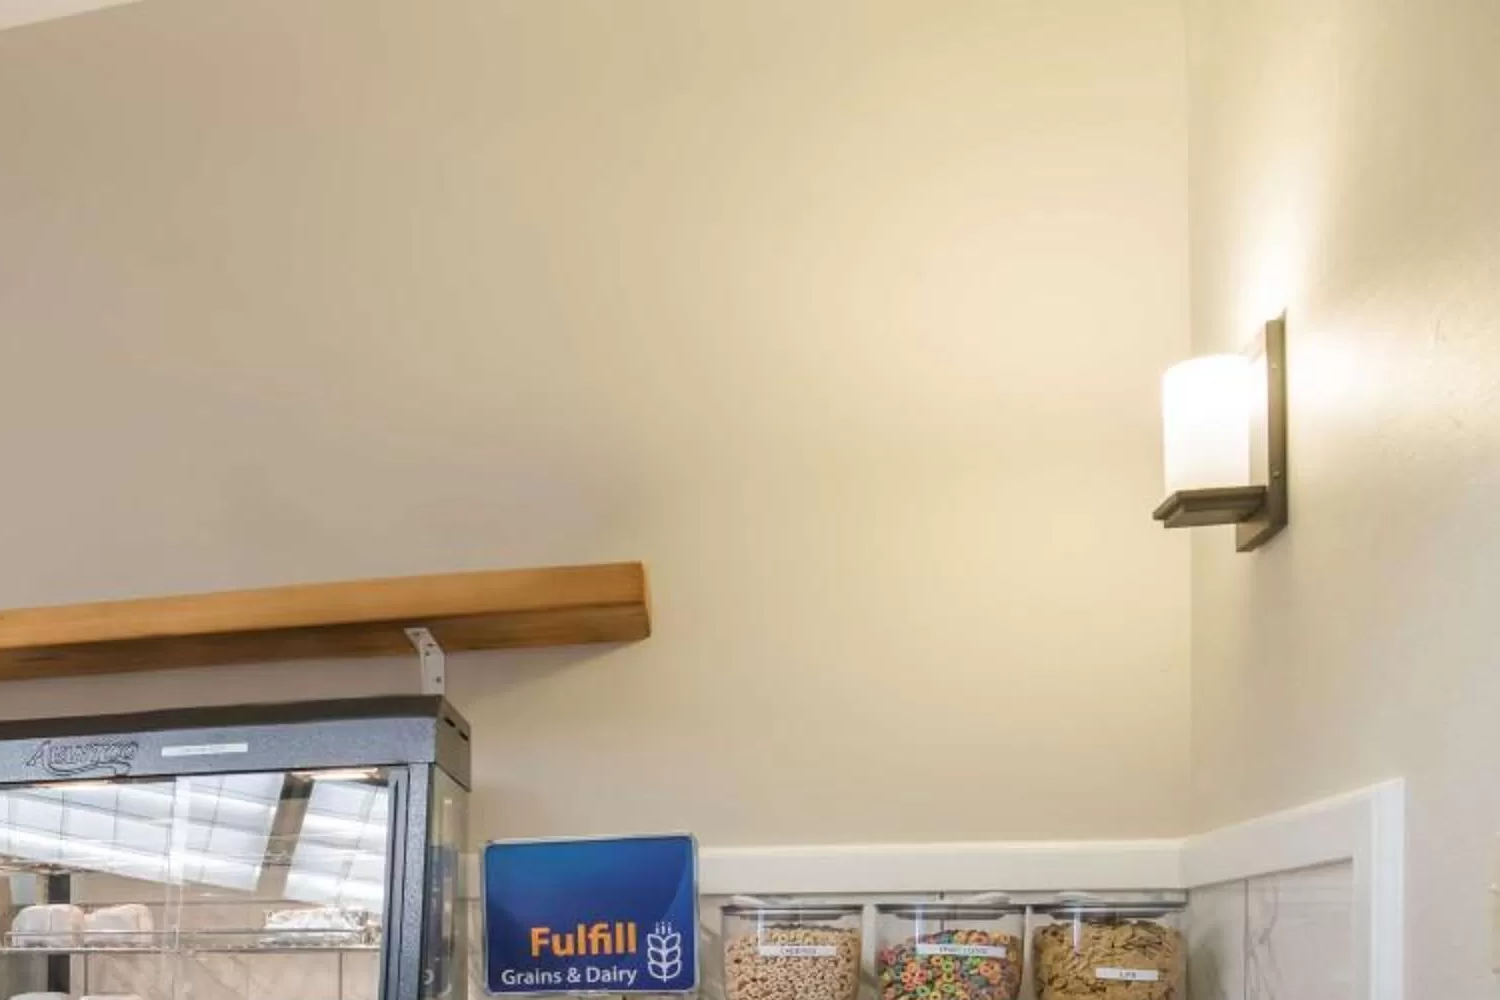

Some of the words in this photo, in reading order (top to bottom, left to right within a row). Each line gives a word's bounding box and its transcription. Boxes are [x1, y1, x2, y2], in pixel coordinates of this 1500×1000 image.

[530, 921, 637, 957] Fulfill
[501, 968, 563, 985] Grains
[567, 967, 581, 983] &
[586, 965, 637, 986] Dairy
